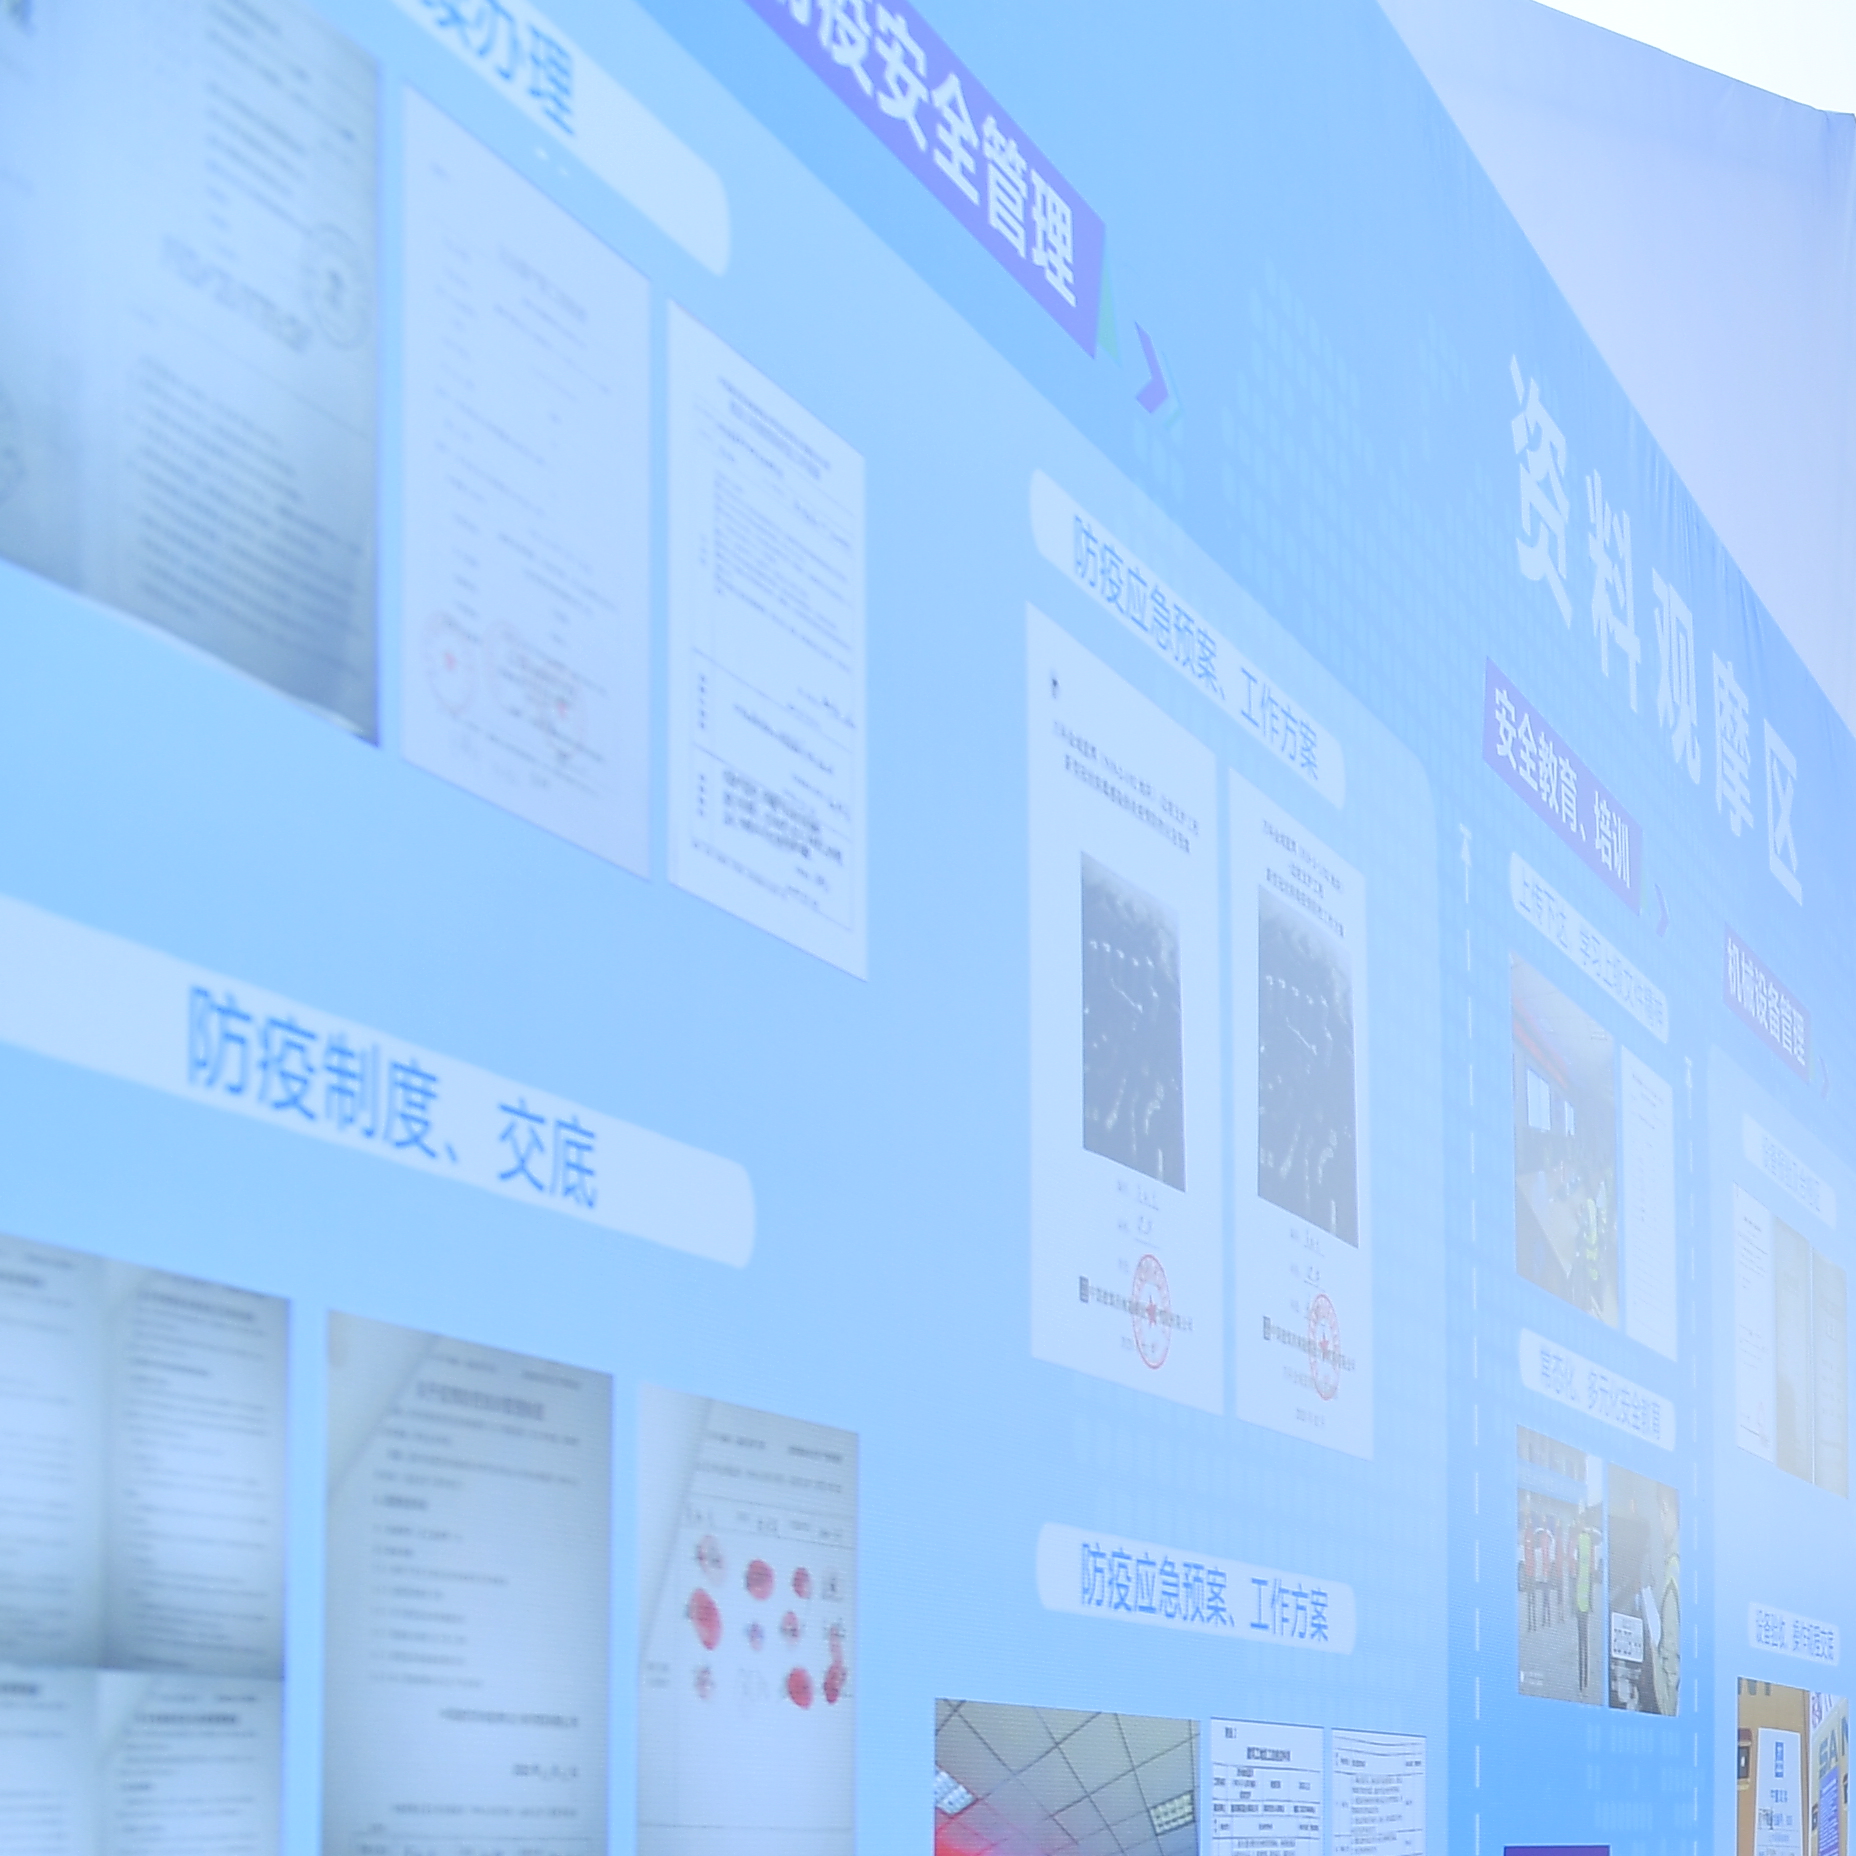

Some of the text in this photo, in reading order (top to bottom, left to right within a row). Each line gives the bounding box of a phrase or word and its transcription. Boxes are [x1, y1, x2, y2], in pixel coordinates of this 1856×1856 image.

[775, 0, 1077, 308] 疫安全管理
[1073, 513, 1321, 782] 防疫应急预案、工作方案
[1510, 354, 1803, 906] 资料观摩区
[1495, 688, 1632, 890] 安全教育、培训
[188, 984, 600, 1210] 防疫制度、交底
[1080, 1540, 1331, 1644] 防疫应急预案、工作方案
